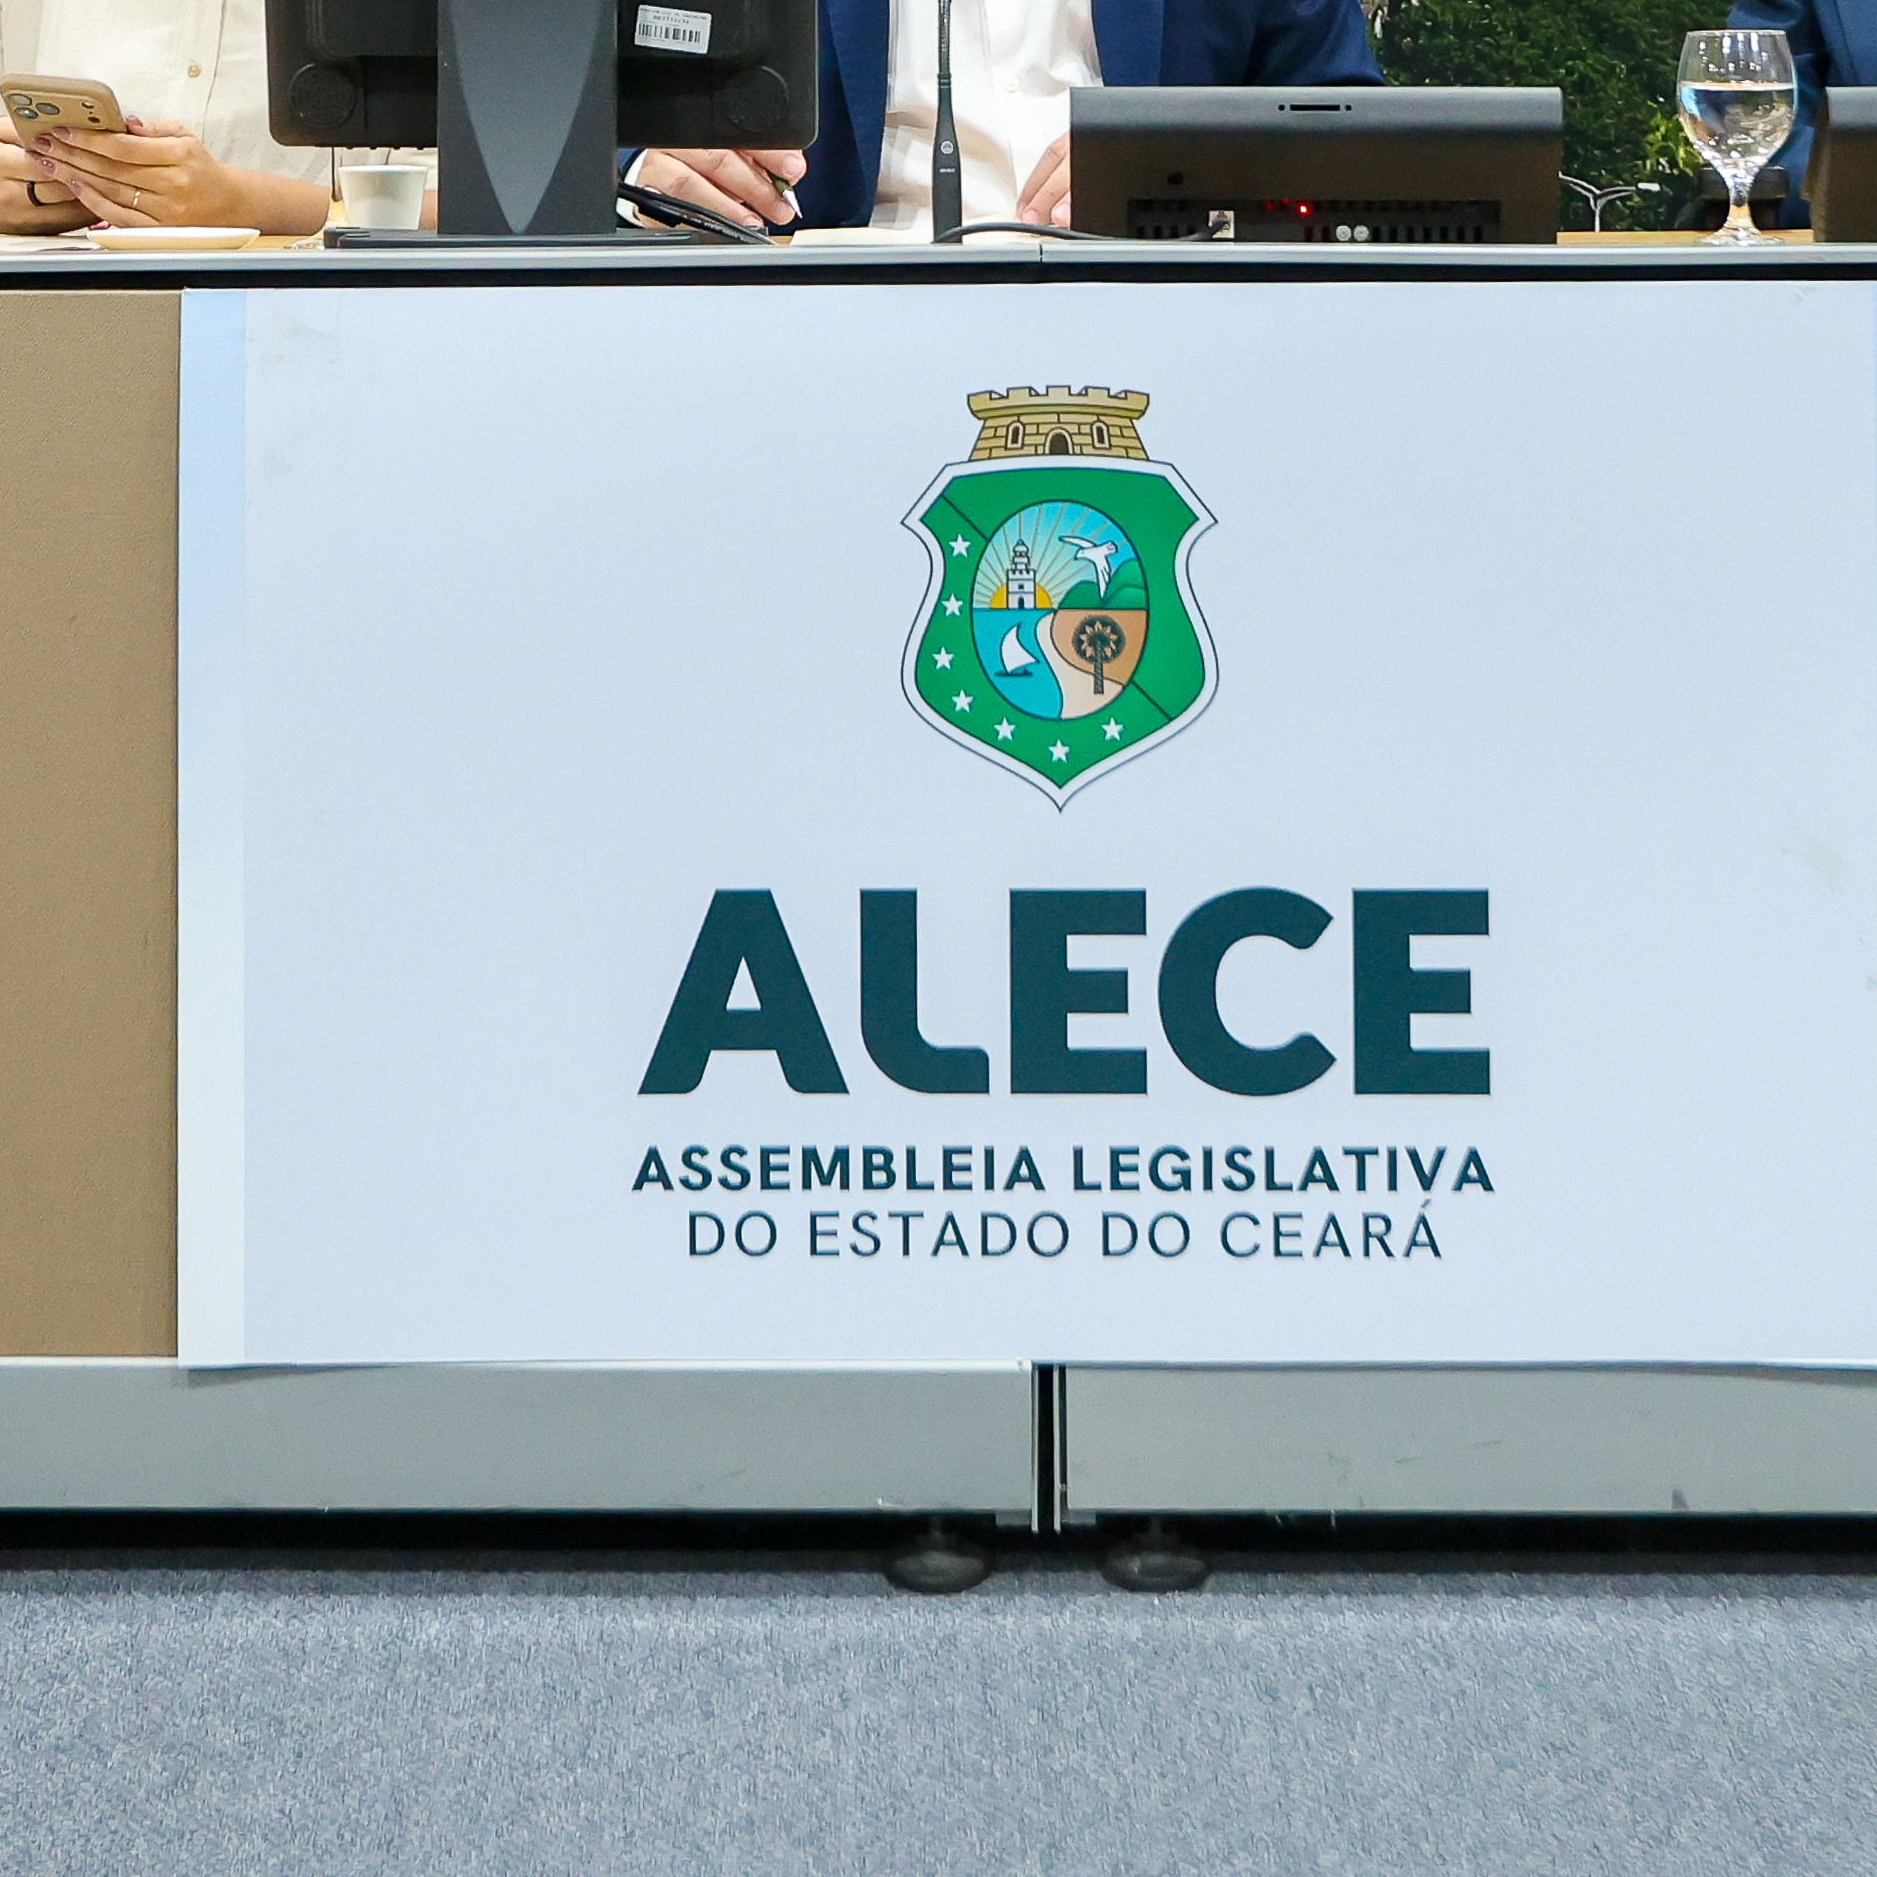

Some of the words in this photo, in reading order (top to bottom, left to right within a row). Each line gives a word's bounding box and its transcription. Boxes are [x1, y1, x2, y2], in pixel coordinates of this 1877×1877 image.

[638, 887, 1490, 1097] ALECE
[632, 1146, 1045, 1191] ASSEMBLEIA
[1073, 1146, 1494, 1192] LEGISLATIVA
[689, 1211, 776, 1256] DO
[810, 1212, 1069, 1257] ESTADO
[1102, 1213, 1190, 1257] DO
[1221, 1200, 1441, 1258] CEARÁ
